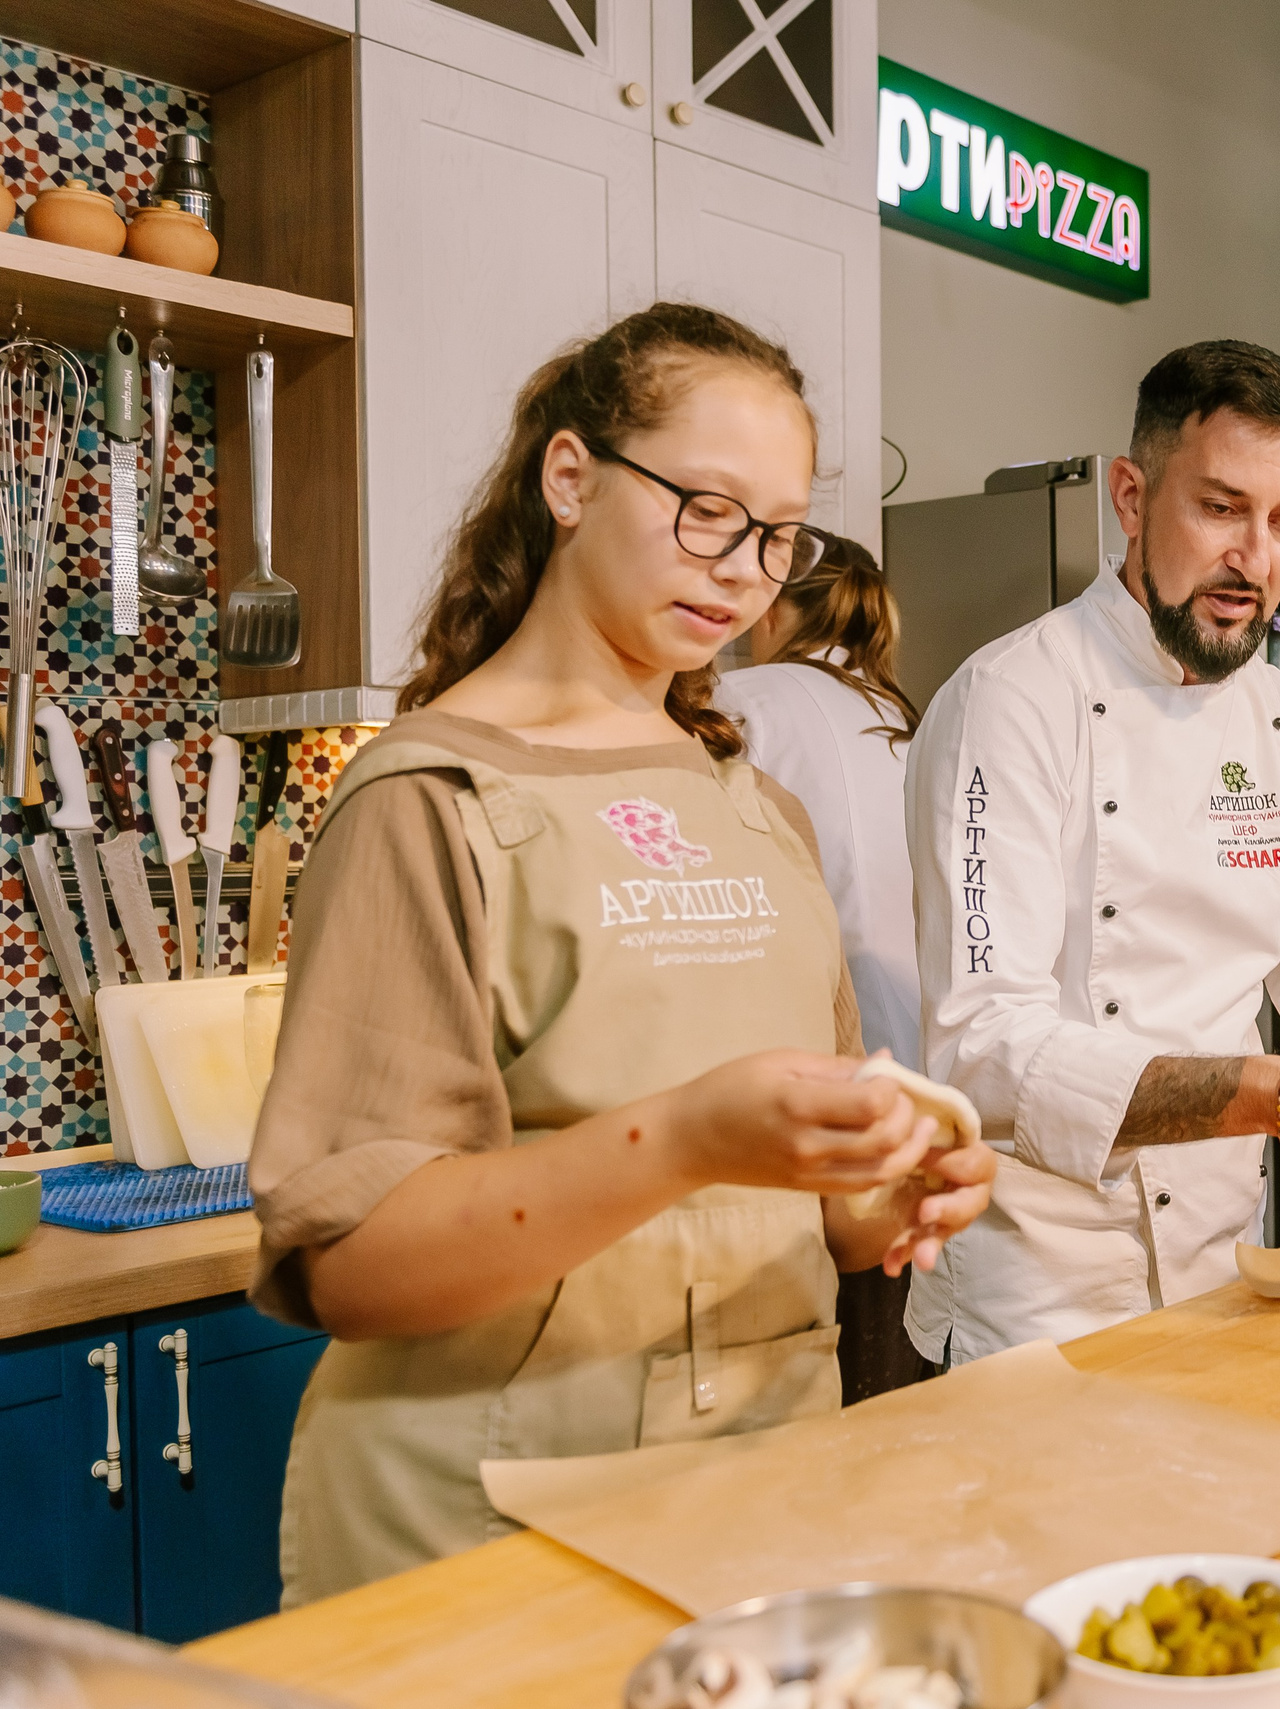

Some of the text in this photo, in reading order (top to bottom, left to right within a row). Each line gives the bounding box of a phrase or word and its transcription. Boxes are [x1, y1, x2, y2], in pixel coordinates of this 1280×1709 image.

[121, 369, 134, 421] Microplane
[1210, 793, 1278, 811] АРТИШОК
[1232, 824, 1258, 836] ШЕФ
[963, 766, 993, 973] АРТИШОК
[600, 877, 779, 927] АРТИШОК
